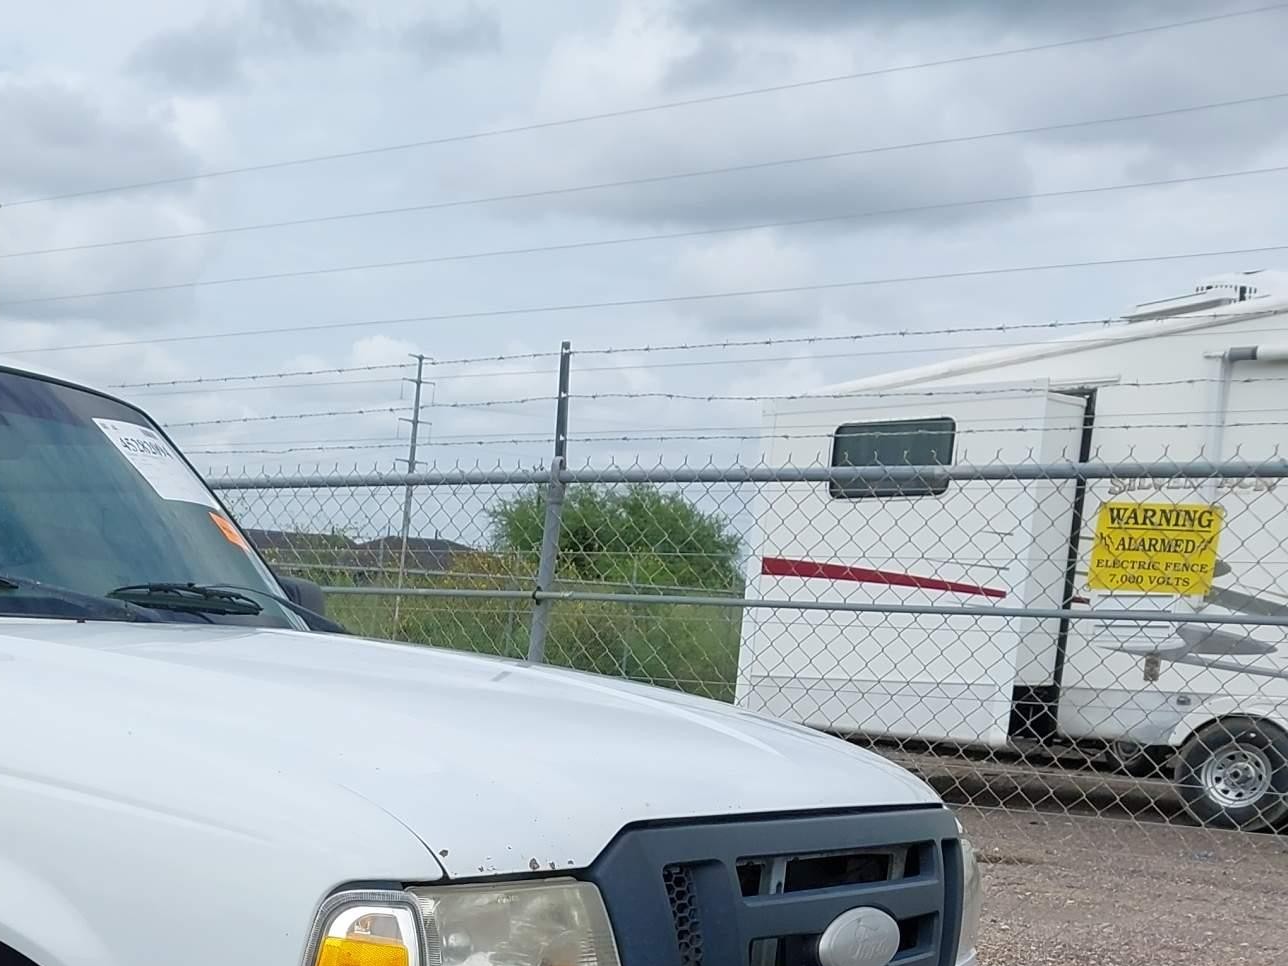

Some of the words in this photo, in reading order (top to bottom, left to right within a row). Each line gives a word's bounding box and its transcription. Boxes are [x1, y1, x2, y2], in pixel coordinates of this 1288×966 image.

[1108, 507, 1215, 529] WARNING
[1115, 536, 1197, 554] ALARMED
[1096, 559, 1161, 571] ELECTRIC
[1164, 562, 1209, 574] FENCE
[1109, 574, 1144, 586] 7,000
[1149, 576, 1191, 588] VOLTS
